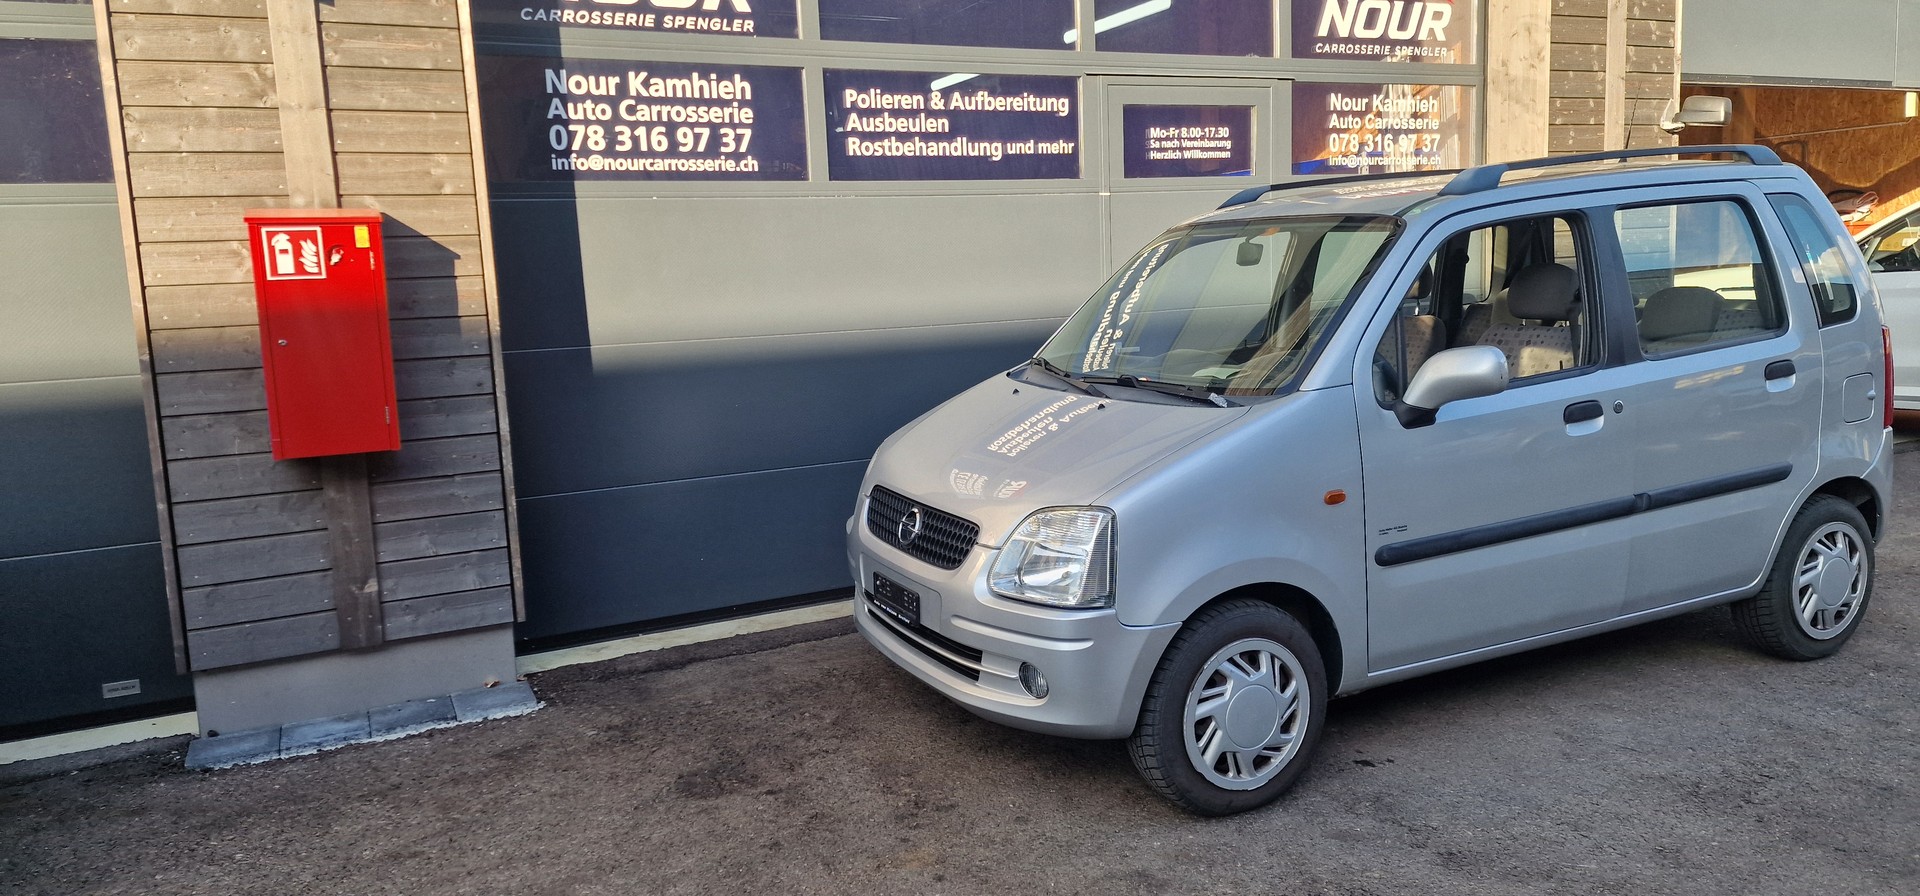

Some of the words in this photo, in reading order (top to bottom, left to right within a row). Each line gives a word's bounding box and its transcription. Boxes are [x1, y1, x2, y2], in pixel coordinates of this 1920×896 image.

[520, 7, 655, 27] CARROSSERIE
[663, 15, 755, 33] SPENGLER
[1318, 0, 1452, 41] NOUR
[1315, 43, 1390, 55] CARROSSERIE
[1395, 46, 1447, 57] SPENGLER
[545, 69, 620, 96] Nour
[628, 71, 751, 99] Kamhieh
[547, 98, 612, 120] Auto
[619, 99, 753, 123] Carrosserie
[845, 88, 924, 109] Polieren
[930, 91, 945, 110] &
[950, 91, 1069, 116] Aufbereitung
[1330, 93, 1368, 111] Nour
[1373, 94, 1438, 113] Kamhieh
[846, 112, 949, 132] Ausbeulen
[1329, 113, 1361, 129] Auto
[1365, 114, 1439, 130] Carrosserie
[549, 124, 606, 151] 078
[615, 126, 667, 151] 316
[677, 127, 710, 152] 97
[720, 128, 752, 153] 37
[1150, 127, 1179, 138] Mo-Fr
[1181, 127, 1229, 138] 8.00-17.30
[1329, 133, 1359, 152] 078
[1364, 133, 1394, 152] 316
[1399, 133, 1417, 152] 97
[1422, 133, 1440, 152] 37
[847, 137, 1002, 161] Rostbehandlung
[1007, 140, 1033, 154] und
[1038, 139, 1074, 154] mehr
[1150, 139, 1160, 148] Sa
[1162, 139, 1179, 148] nach
[1181, 139, 1231, 149] Vereinbarung
[551, 153, 759, 172] info@nourcarrosserie.ch
[1150, 150, 1181, 159] Herzlich
[1183, 150, 1231, 159] Willkommen
[1329, 155, 1441, 168] info@nourcarrosserie.ch
